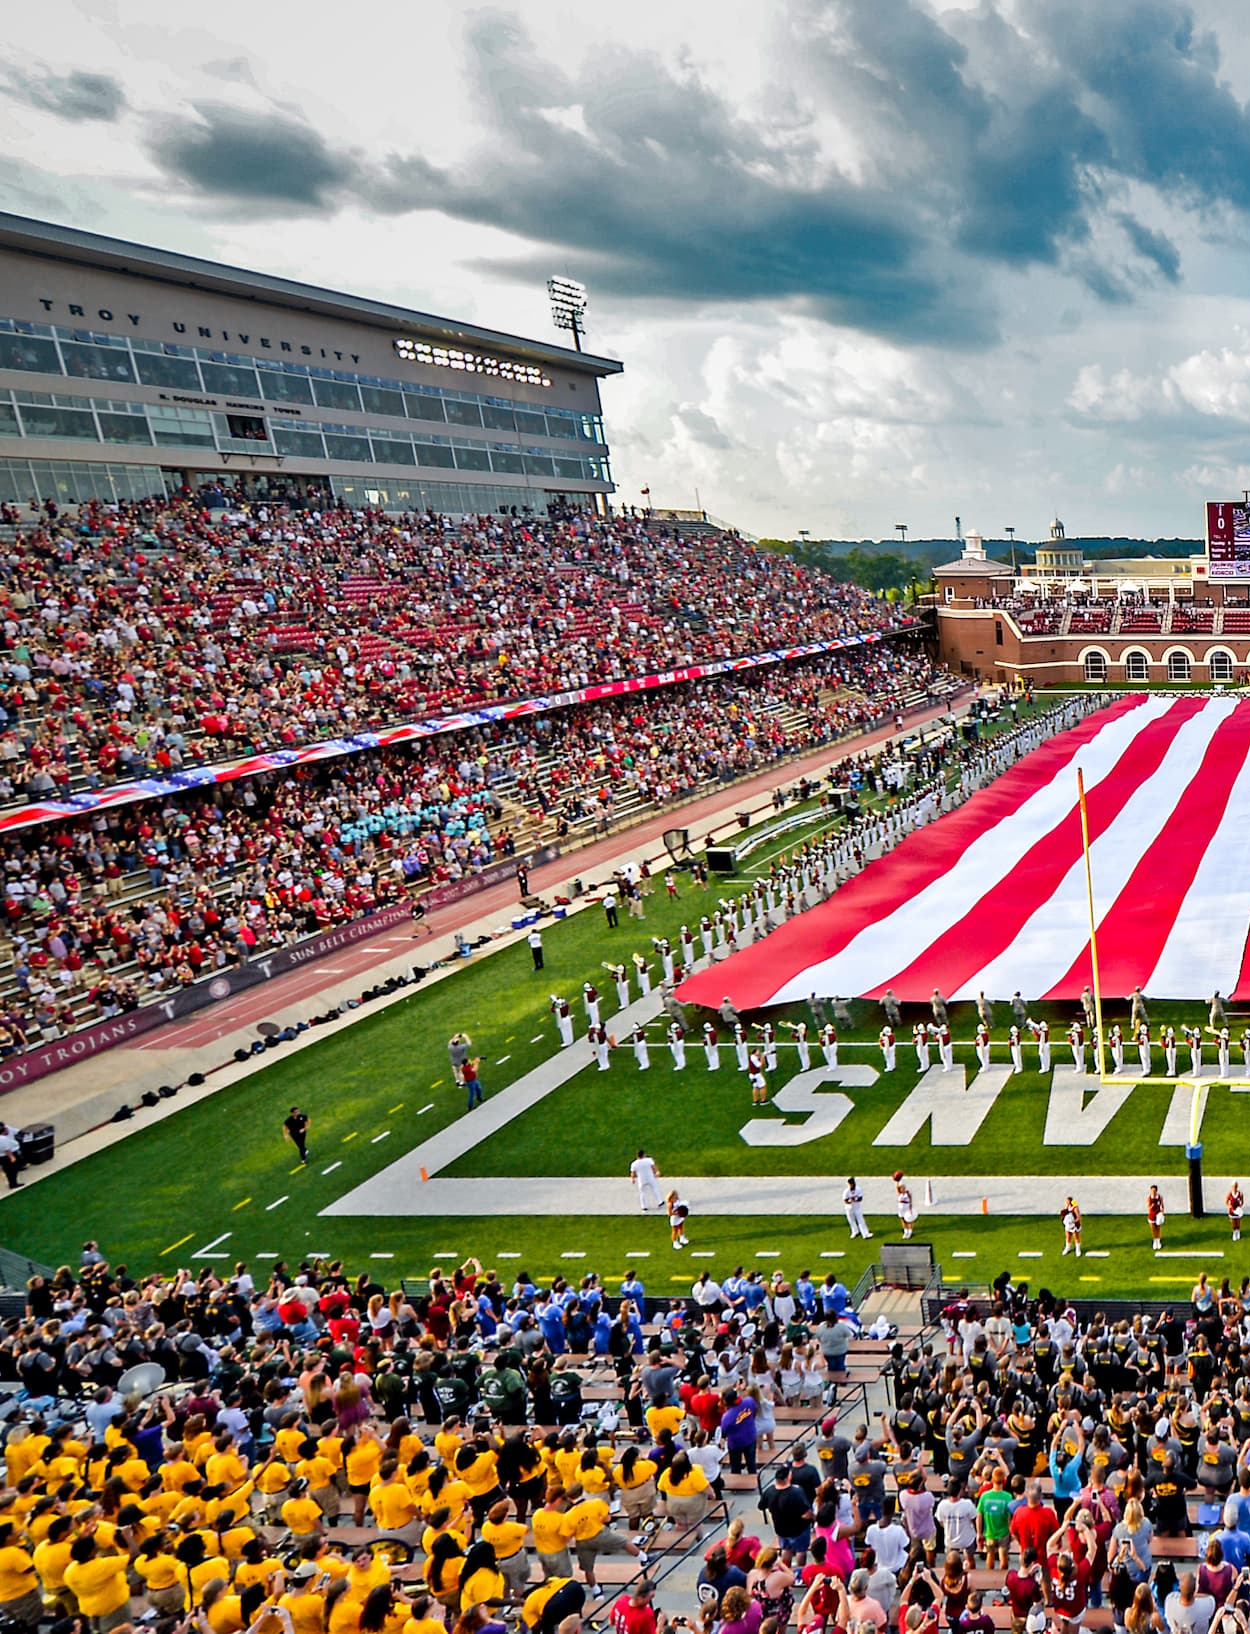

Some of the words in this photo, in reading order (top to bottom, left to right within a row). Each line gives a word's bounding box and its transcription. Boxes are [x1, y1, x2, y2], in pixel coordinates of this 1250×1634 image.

[39, 299, 141, 326] TROY
[172, 321, 362, 364] UNIVERSITY
[1217, 518, 1225, 530] 0
[289, 945, 315, 964] SUN
[319, 933, 347, 951] BELT
[40, 1019, 137, 1066] TROJANS
